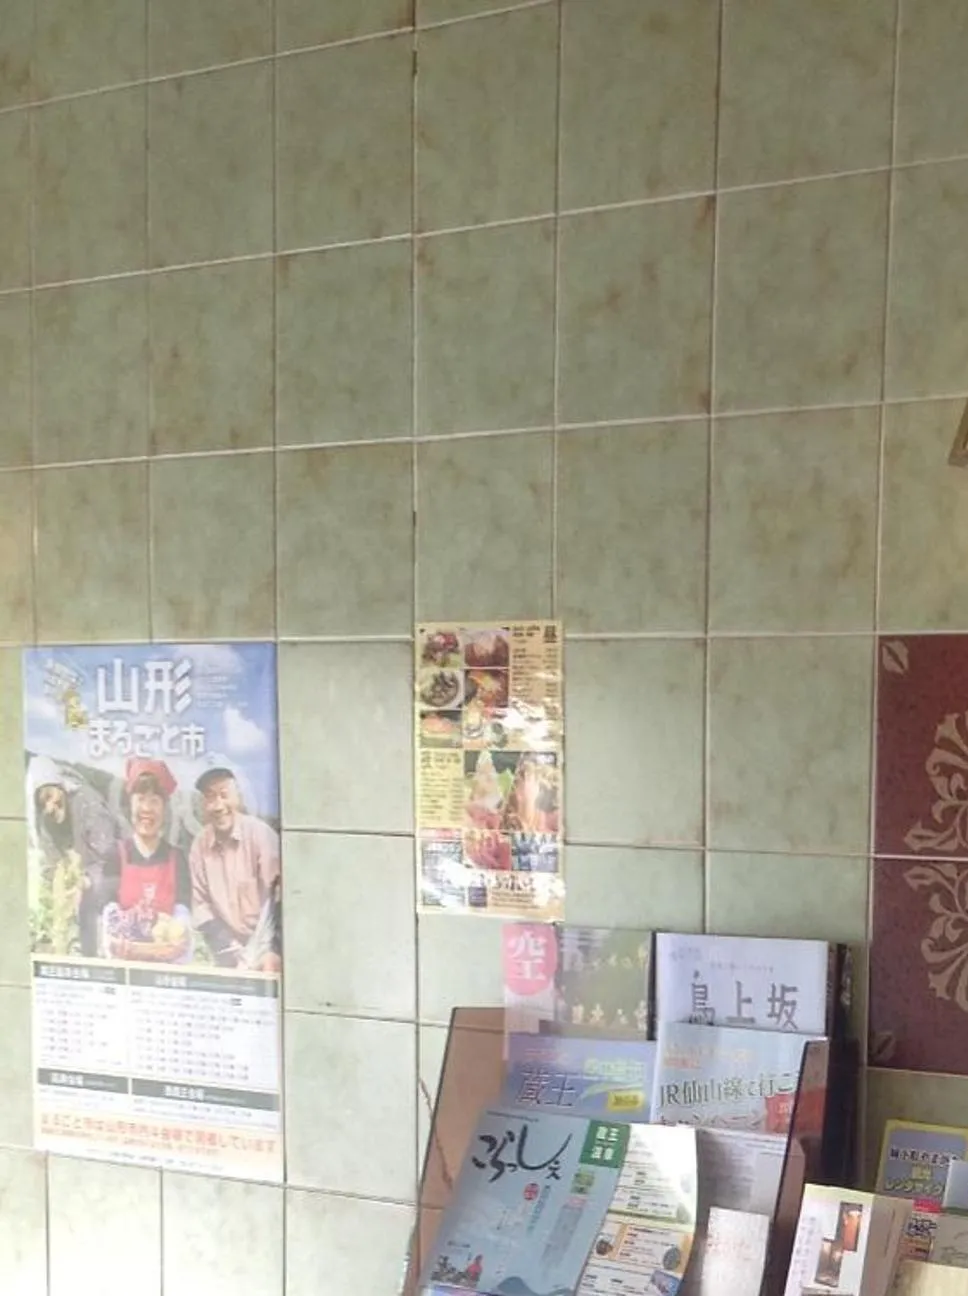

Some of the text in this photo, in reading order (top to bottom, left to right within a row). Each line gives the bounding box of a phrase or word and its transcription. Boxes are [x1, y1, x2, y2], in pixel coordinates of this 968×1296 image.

[97, 657, 193, 715] 山形
[86, 716, 206, 758] まるごと市
[507, 927, 548, 981] 空
